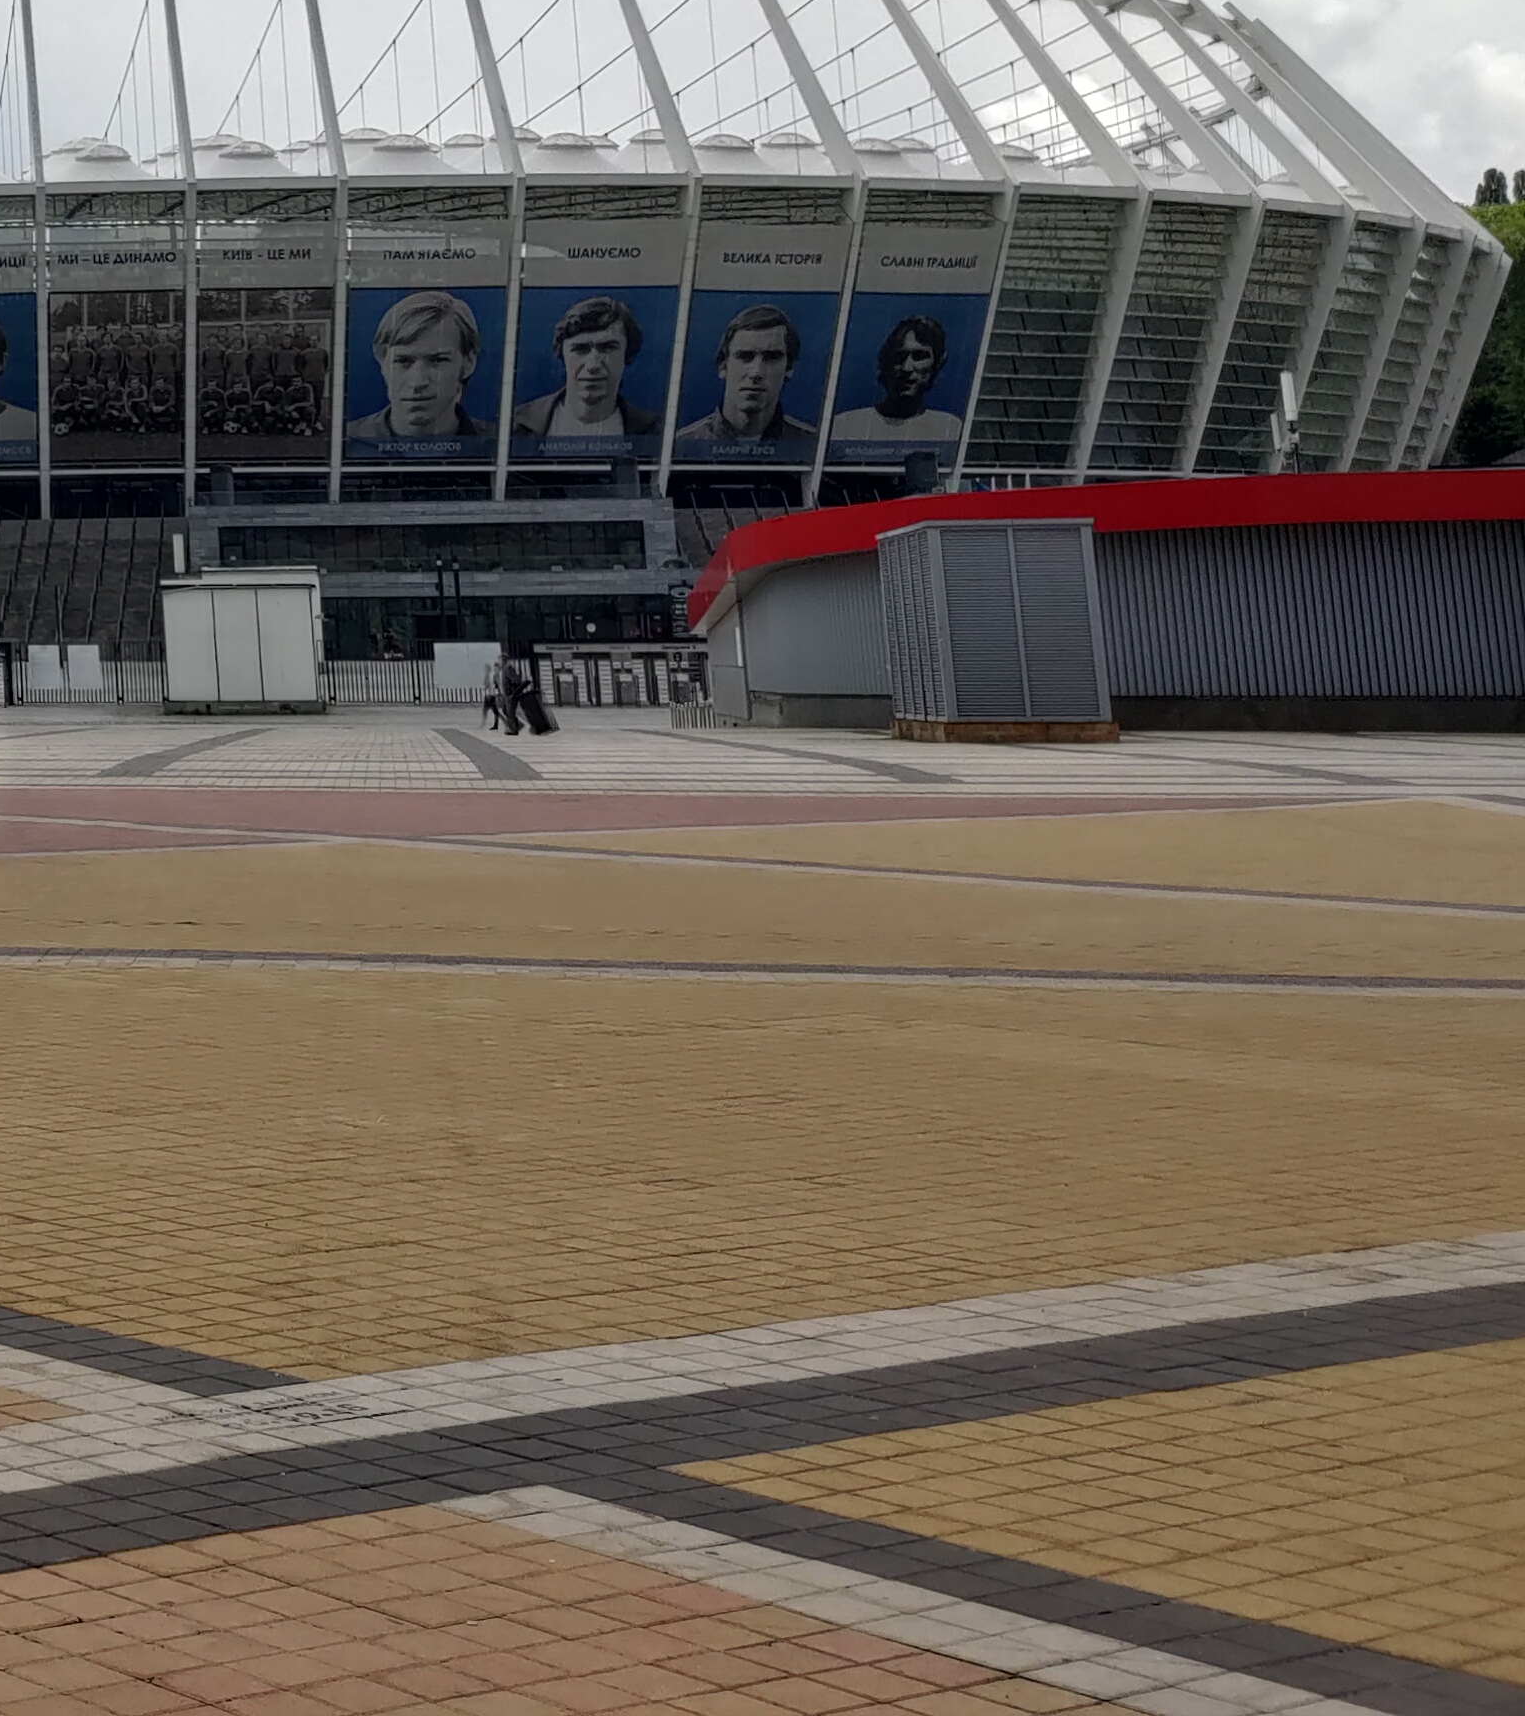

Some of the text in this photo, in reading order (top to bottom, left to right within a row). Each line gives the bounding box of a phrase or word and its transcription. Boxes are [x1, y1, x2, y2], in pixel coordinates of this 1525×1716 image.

[57, 253, 79, 266] МИ
[93, 252, 110, 266] ЦЕ
[113, 251, 177, 265] ДИНАМО
[222, 248, 253, 261] КИЇВ
[267, 248, 285, 262] ЦЕ
[288, 248, 311, 260] МИ
[567, 247, 641, 260] ШАНУЄМО
[723, 252, 823, 266] ВЕЛИКА ІСТОРІЯ
[881, 255, 978, 270] СЛАВНІ ТРАДИЦІЇ
[378, 441, 462, 452] ВІКТОР КОЛОТОВ
